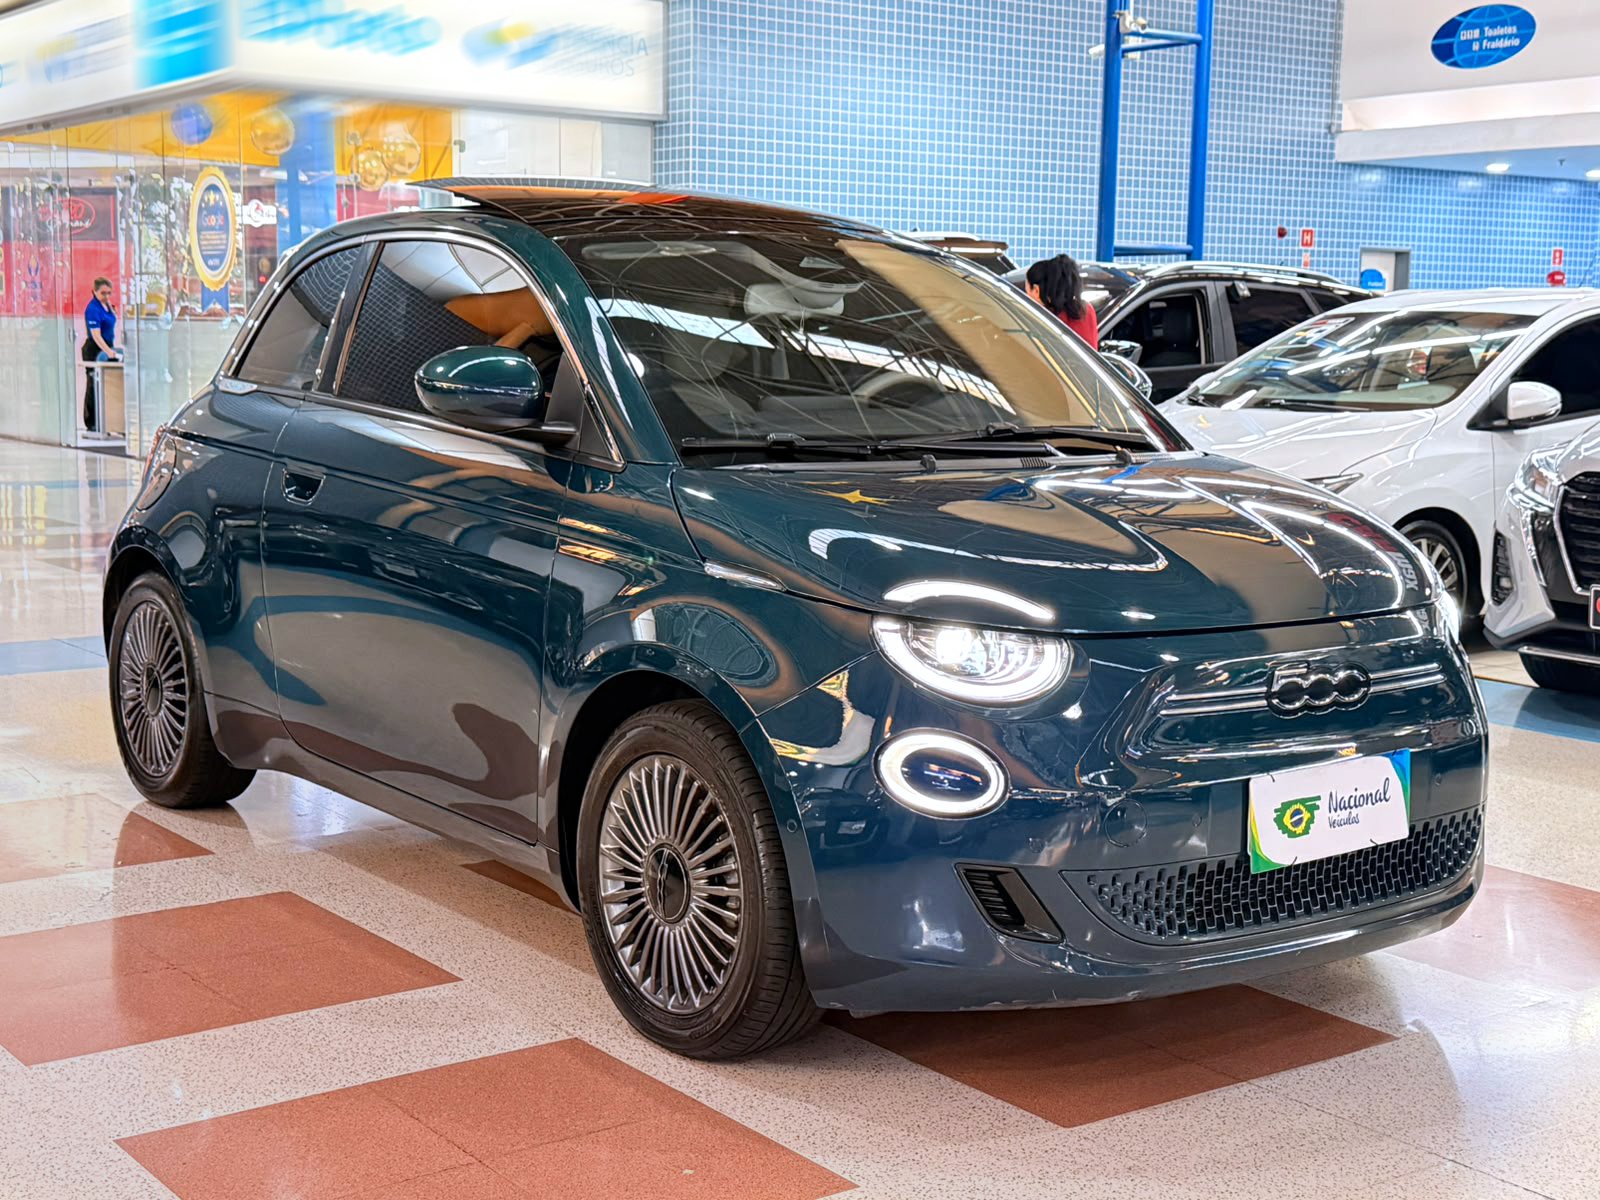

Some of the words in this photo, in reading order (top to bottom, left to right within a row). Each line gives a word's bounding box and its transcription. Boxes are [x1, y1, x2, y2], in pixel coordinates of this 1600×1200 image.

[1484, 25, 1517, 38] Toaletes
[1482, 36, 1520, 50] Fraldário
[1303, 231, 1312, 246] H
[1270, 663, 1370, 714] 500
[1328, 777, 1391, 814] Nacional
